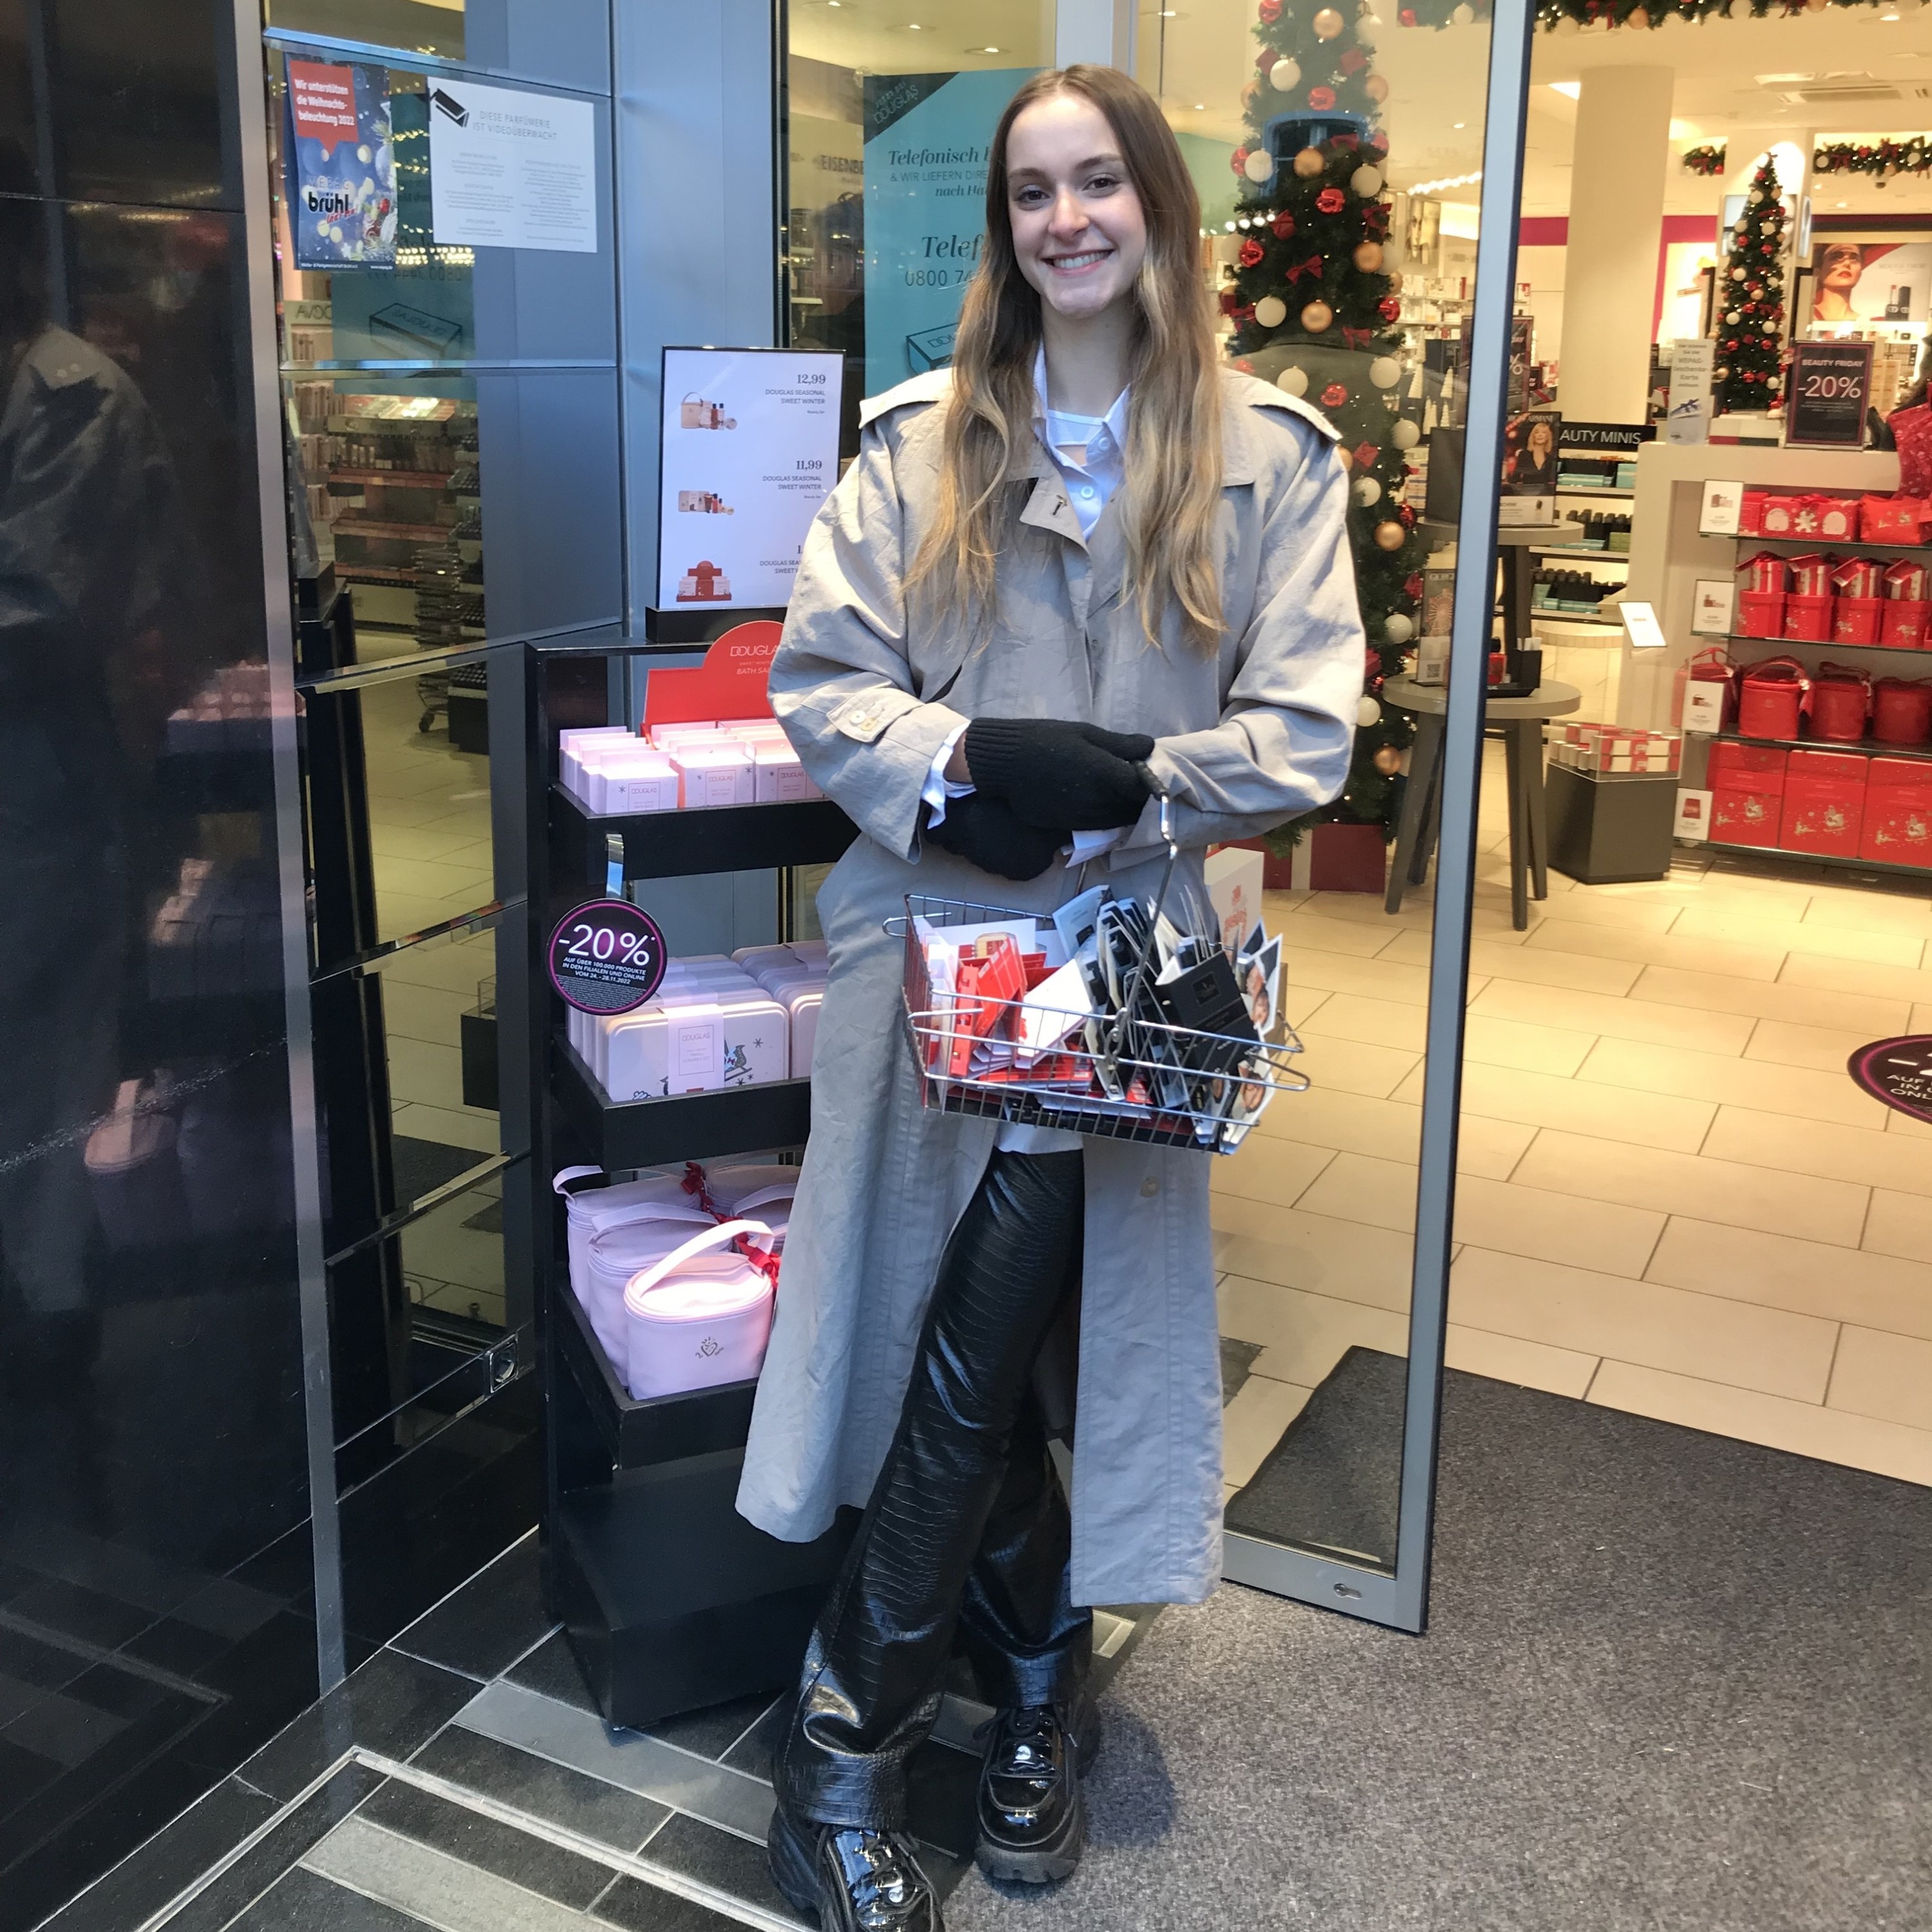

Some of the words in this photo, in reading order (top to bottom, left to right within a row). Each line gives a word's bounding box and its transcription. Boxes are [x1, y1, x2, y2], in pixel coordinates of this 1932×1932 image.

[294, 79, 307, 90] Wir
[308, 82, 349, 95] unterstützen
[296, 95, 307, 105] die
[308, 97, 348, 109] Weihnachts-
[874, 85, 919, 124] DOUGLAS
[298, 110, 338, 126] beleuchtung
[338, 115, 355, 126] 2022
[480, 111, 502, 121] DIESE
[504, 113, 551, 129] PARFÜMERIE
[473, 122, 486, 131] IST
[488, 124, 557, 140] VIDEOÜBERWACHT
[888, 147, 979, 167] Telefonisch
[890, 173, 898, 182] &
[900, 172, 920, 182] WIR
[922, 171, 962, 181] LIEFERN
[935, 185, 965, 196] nach
[308, 191, 349, 213] brühl
[905, 270, 947, 287] 0800
[797, 374, 826, 385] 12,99
[1559, 429, 1599, 443] AUTY
[1600, 430, 1642, 444] MINIS
[796, 460, 822, 471] 11,99
[584, 966, 608, 974] FILIALEN
[623, 972, 645, 981] ONLINE
[616, 965, 647, 976] PRODUKTE
[602, 975, 630, 984] 28.11.2022
[682, 1032, 710, 1042] DOUGLAS
[1887, 1074, 1925, 1084] AUF
